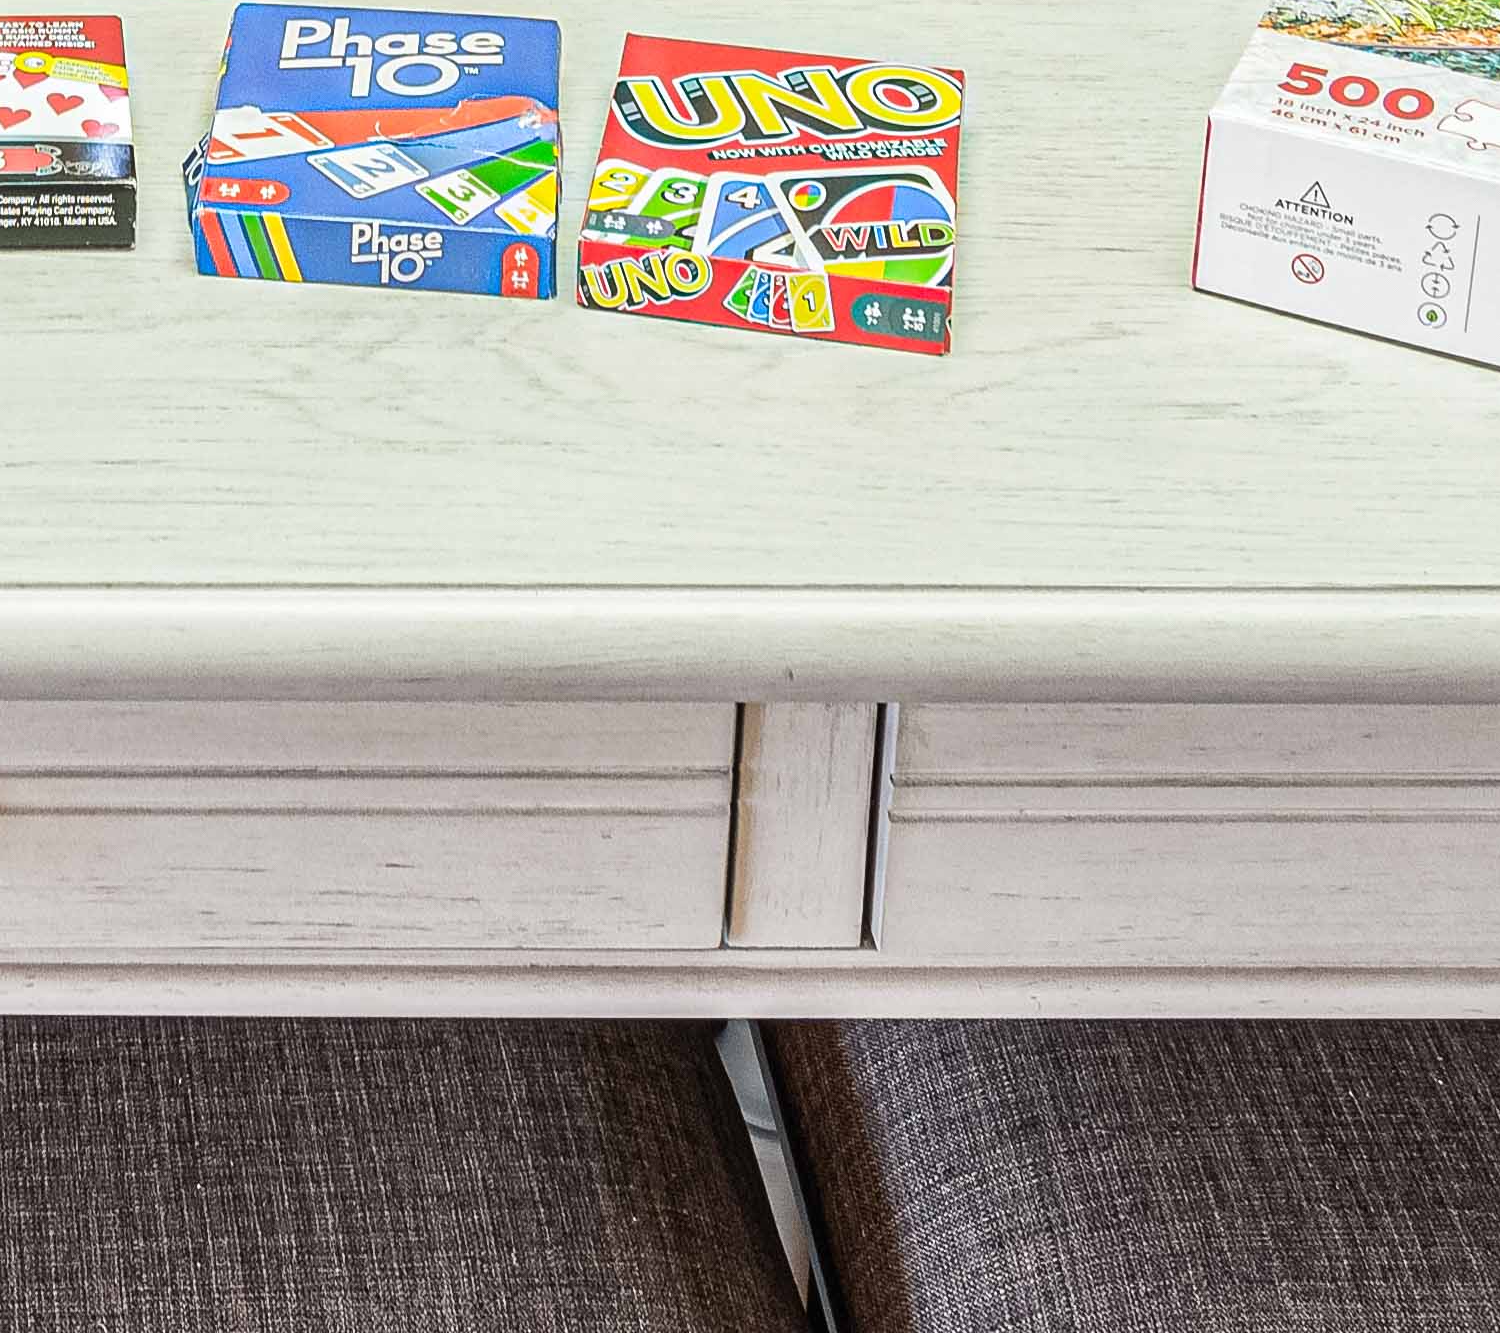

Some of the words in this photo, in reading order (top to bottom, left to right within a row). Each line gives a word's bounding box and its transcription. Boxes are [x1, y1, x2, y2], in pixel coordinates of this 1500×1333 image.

[281, 18, 505, 59] Phase
[345, 55, 459, 97] 10
[1277, 62, 1435, 120] 500
[618, 65, 961, 145] UNO
[713, 149, 757, 159] NOW
[760, 146, 804, 157] WITH
[810, 139, 947, 154] CUSTOMIZABLE
[826, 150, 870, 160] WILD
[875, 147, 942, 159] CARDS!
[1275, 199, 1354, 226] ATTENTION
[351, 222, 444, 251] Phase
[826, 223, 952, 250] WILD
[378, 251, 425, 283] 10
[583, 251, 712, 308] UNO
